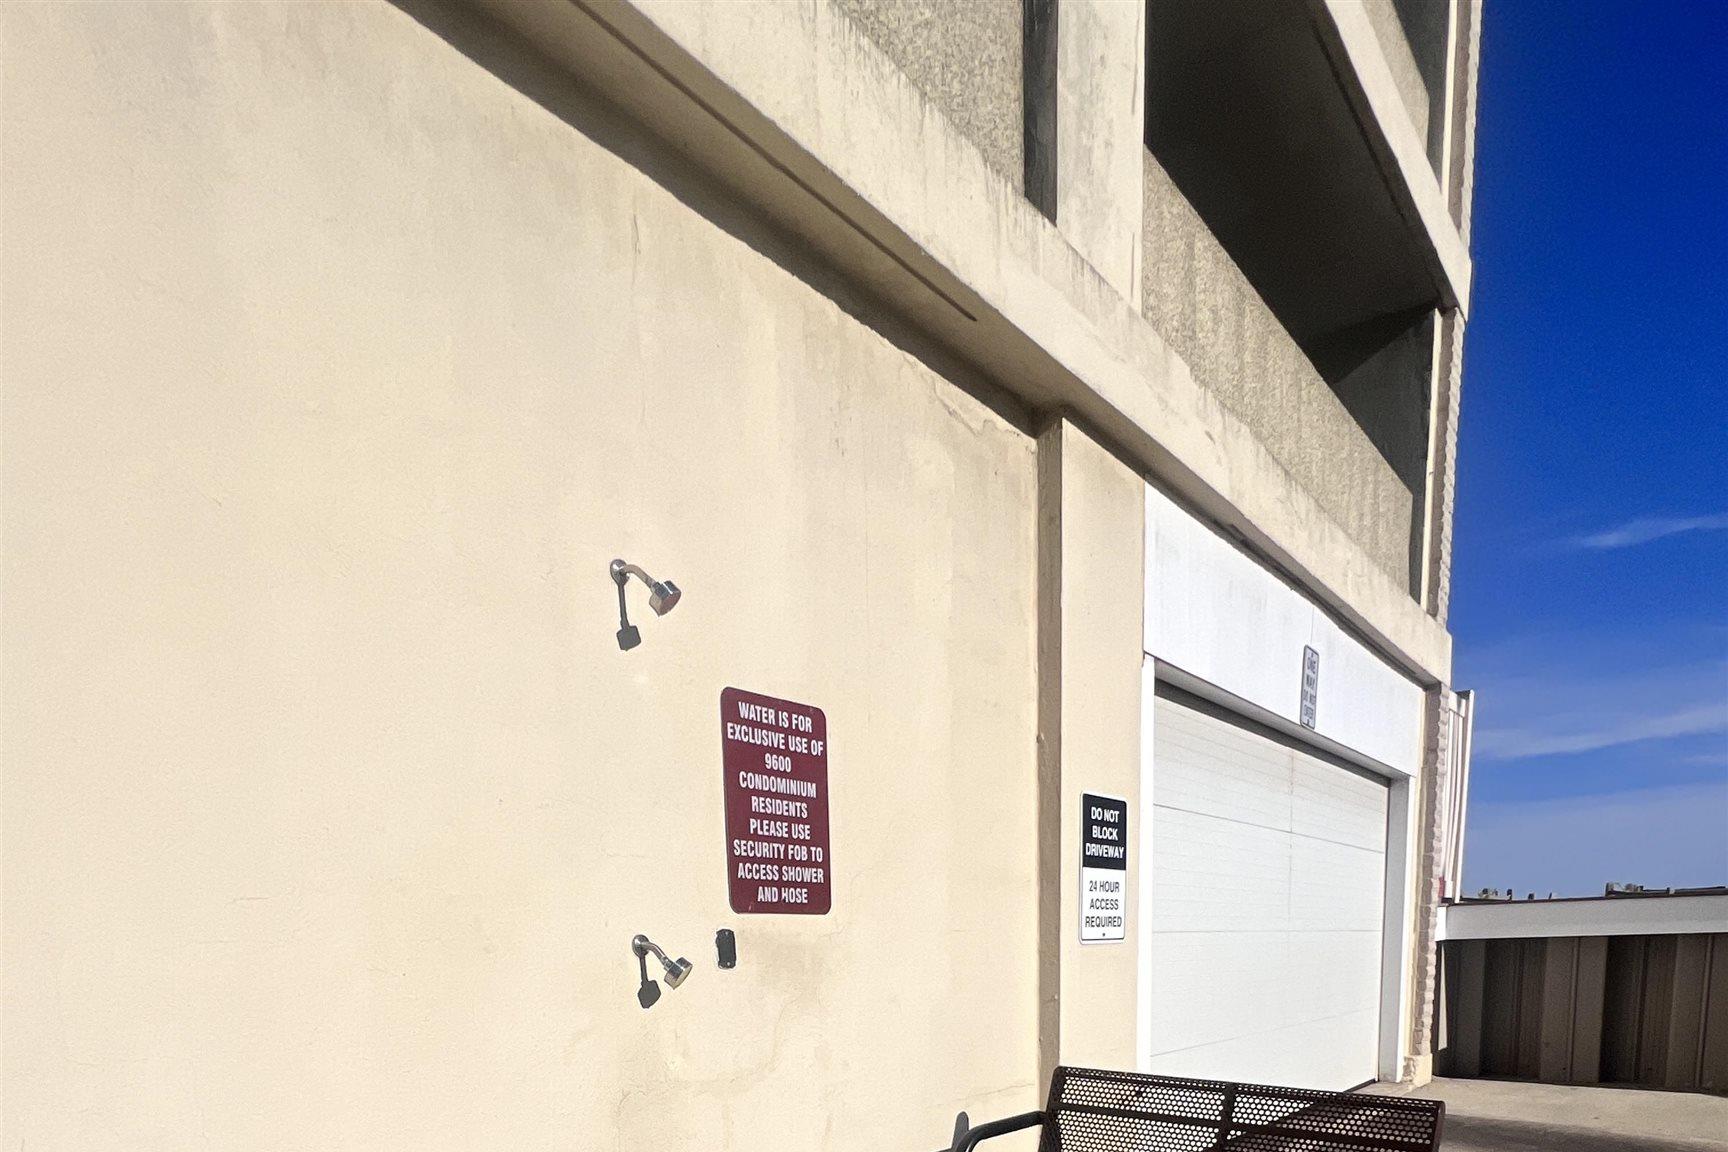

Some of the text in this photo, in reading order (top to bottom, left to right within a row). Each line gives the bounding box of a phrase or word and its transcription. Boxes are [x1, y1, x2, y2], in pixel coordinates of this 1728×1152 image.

[739, 702, 812, 733] WATER IS FOR
[727, 723, 823, 756] EXCLUSIVE USE OF
[765, 754, 791, 772] 9600
[739, 772, 816, 798] CONDOMINIUM
[752, 796, 807, 818] RESIDENTS
[1091, 807, 1119, 822] DO NOT
[750, 819, 810, 839] PLEASE USE
[1092, 826, 1118, 840] BLOCK
[734, 840, 823, 862] SECURITY FOB TO
[1086, 843, 1124, 858] DRIVEWAY
[738, 863, 824, 883] ACCESS SHOWER
[758, 887, 807, 903] AND HOSE
[1089, 881, 1119, 892] 24 HOUR
[1090, 899, 1118, 910] ACCESS
[1085, 916, 1122, 928] REQUIRED
